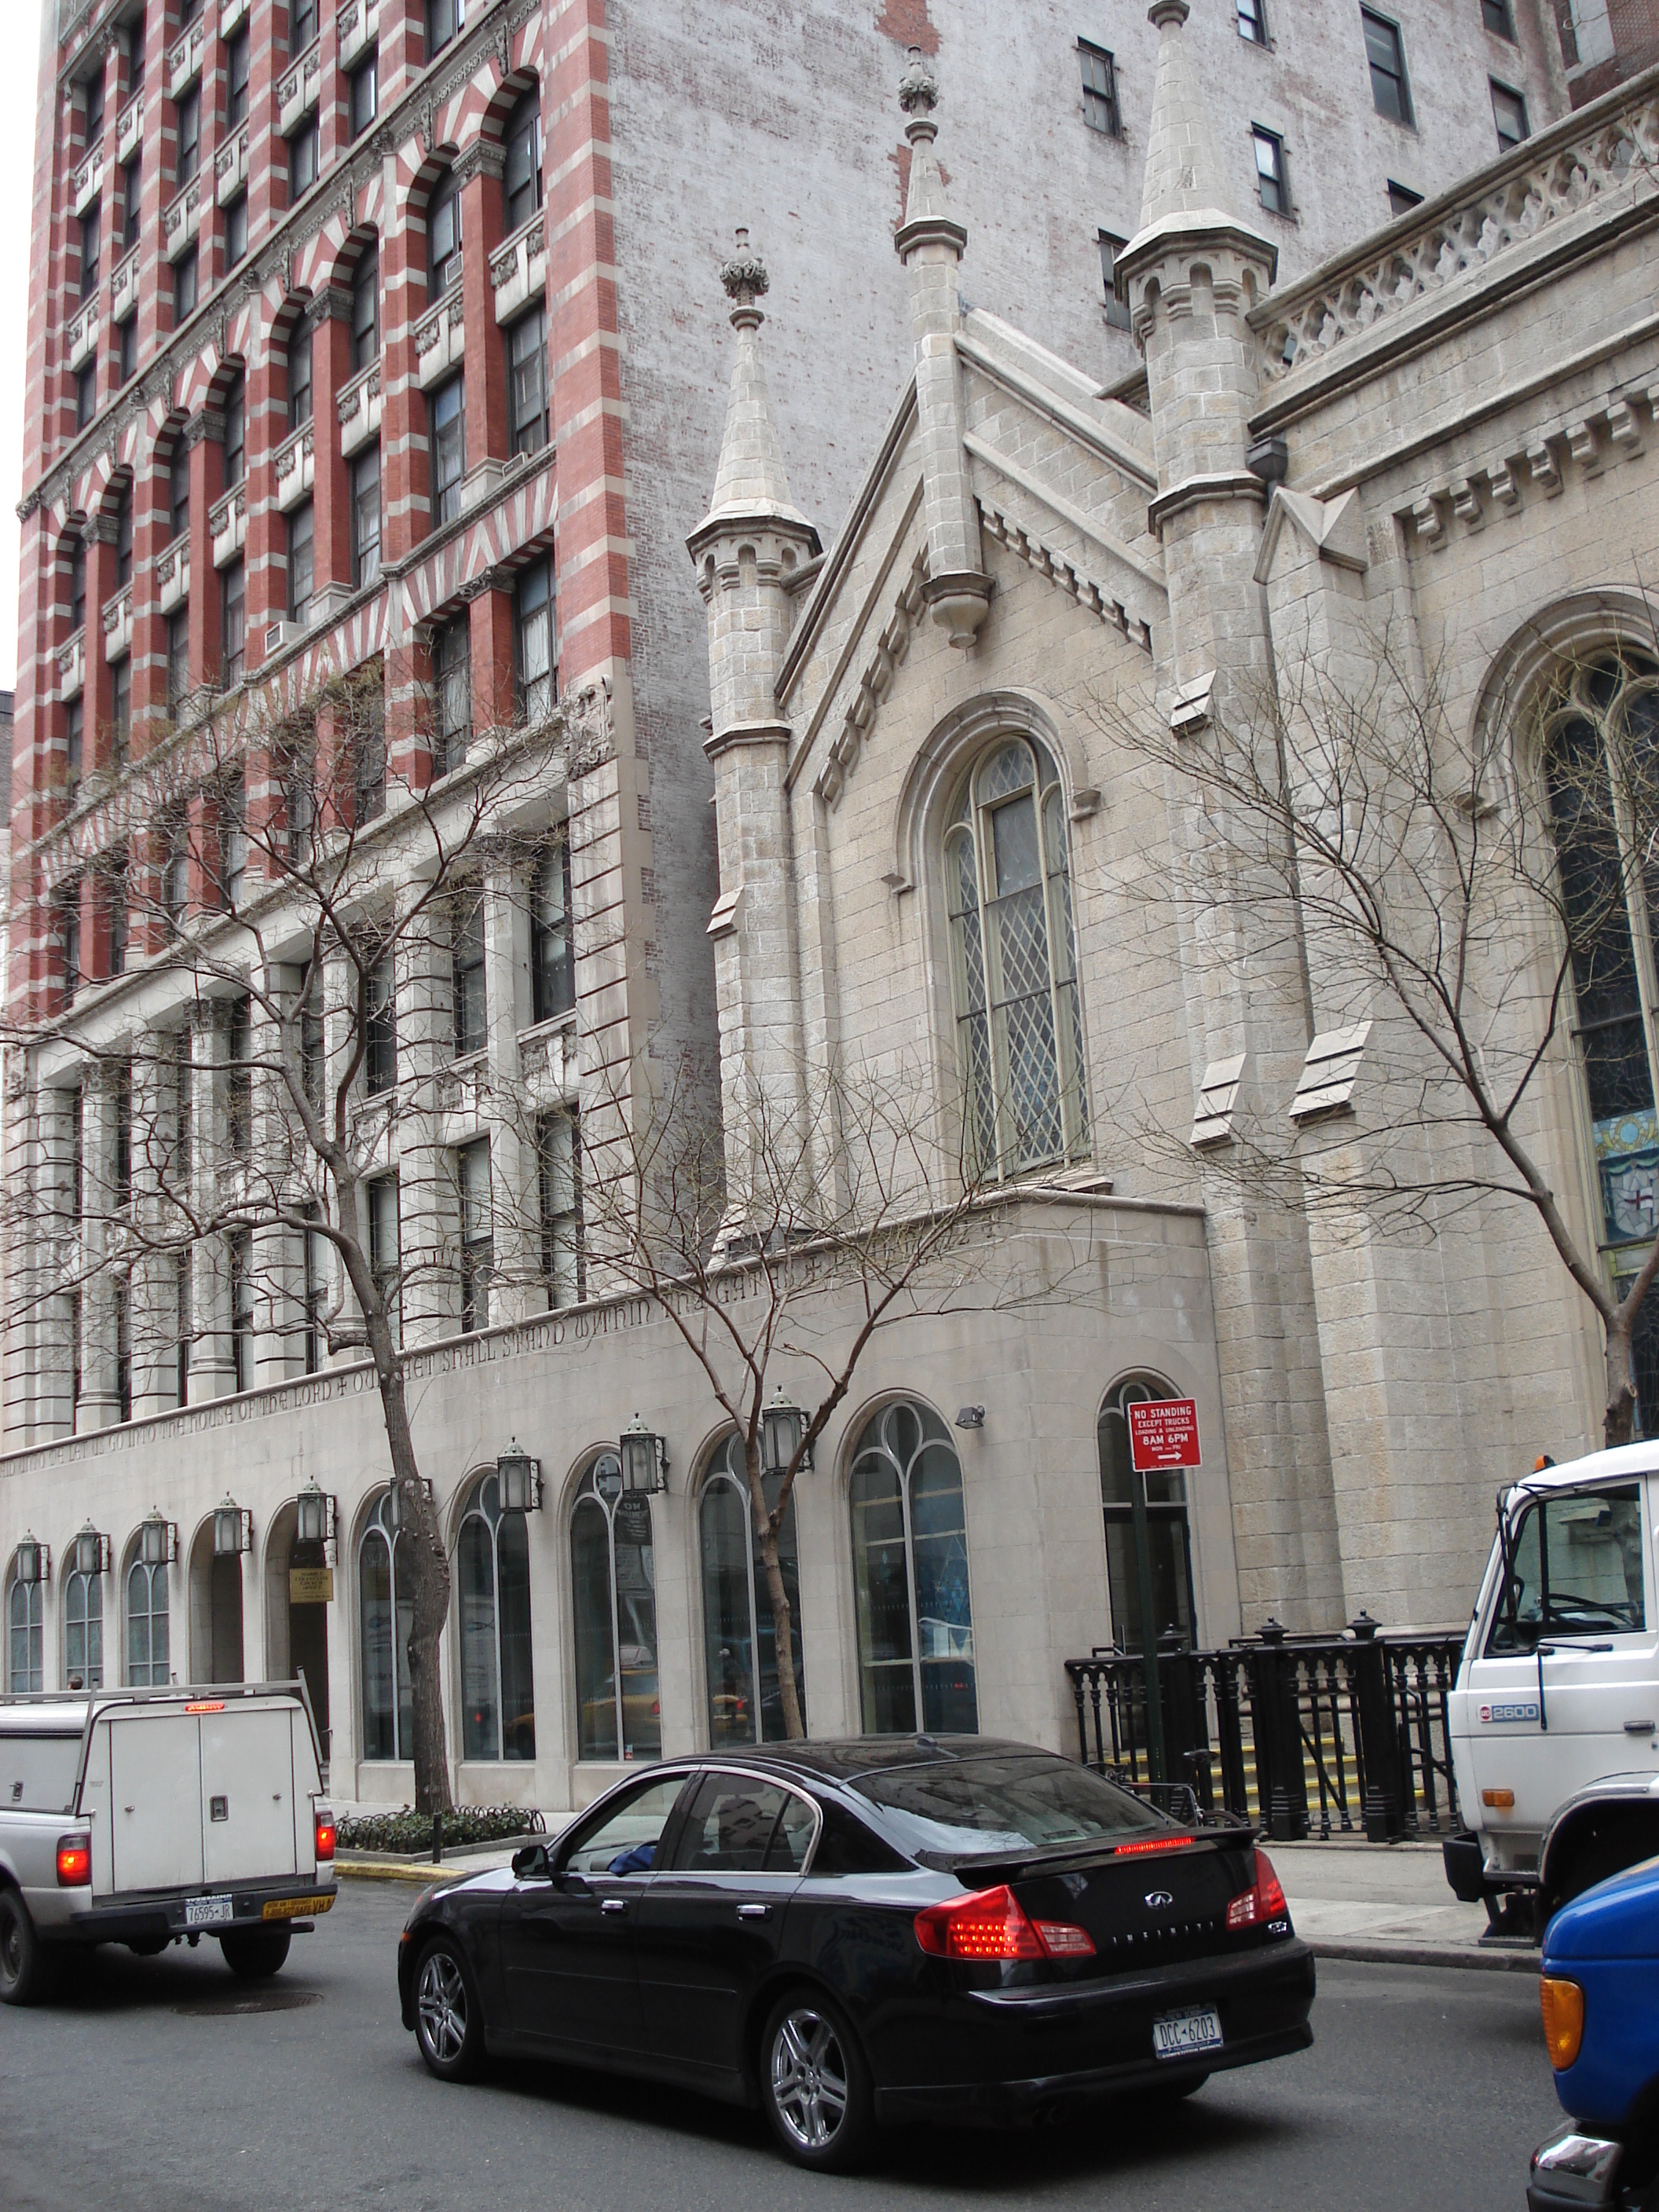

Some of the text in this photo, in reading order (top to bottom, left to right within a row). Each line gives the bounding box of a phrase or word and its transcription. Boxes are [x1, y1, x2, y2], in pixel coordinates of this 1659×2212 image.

[69, 1441, 88, 1461] LET
[92, 1436, 104, 1455] US
[109, 1430, 123, 1452] GO
[128, 1424, 156, 1447] INTO
[161, 1416, 185, 1439] THE
[190, 1404, 233, 1434] HOUSE
[239, 1397, 255, 1421] OF
[260, 1390, 288, 1415] THE
[294, 1380, 331, 1407] LORD
[353, 1367, 381, 1393] OU
[402, 1353, 436, 1380] EET
[442, 1337, 496, 1372] SHALL
[503, 1320, 566, 1357] STAND
[575, 1298, 650, 1339] WITHIN
[1134, 1406, 1192, 1419] NO STANDING
[1137, 1416, 1190, 1428] EXCEPT TRUCKS
[1143, 1433, 1188, 1445] 8AM 6PM
[1492, 1705, 1537, 1719] 2600
[189, 1903, 230, 1921] 76595 JR
[1159, 2016, 1216, 2047] DCC 6203
